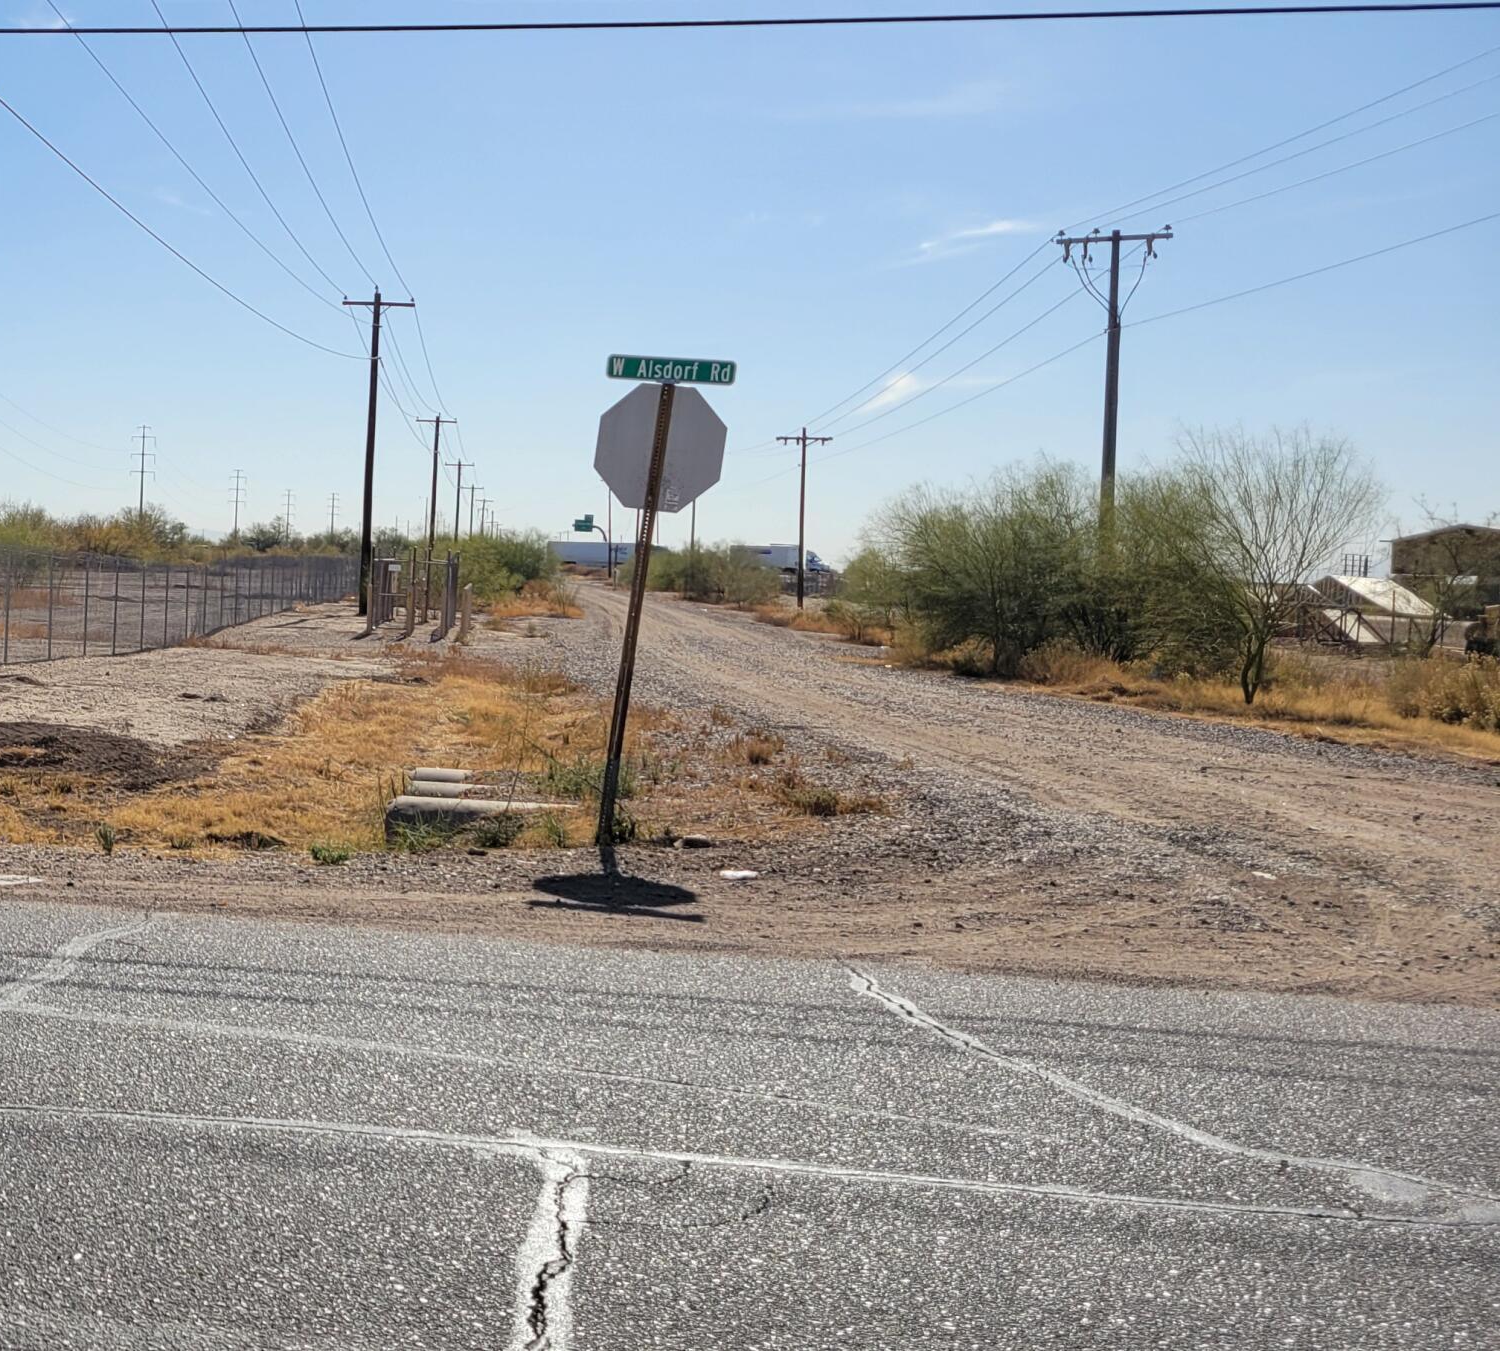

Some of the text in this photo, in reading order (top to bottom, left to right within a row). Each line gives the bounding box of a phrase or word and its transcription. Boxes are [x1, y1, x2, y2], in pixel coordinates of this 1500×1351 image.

[613, 358, 731, 382] W Alsdorf Rd
